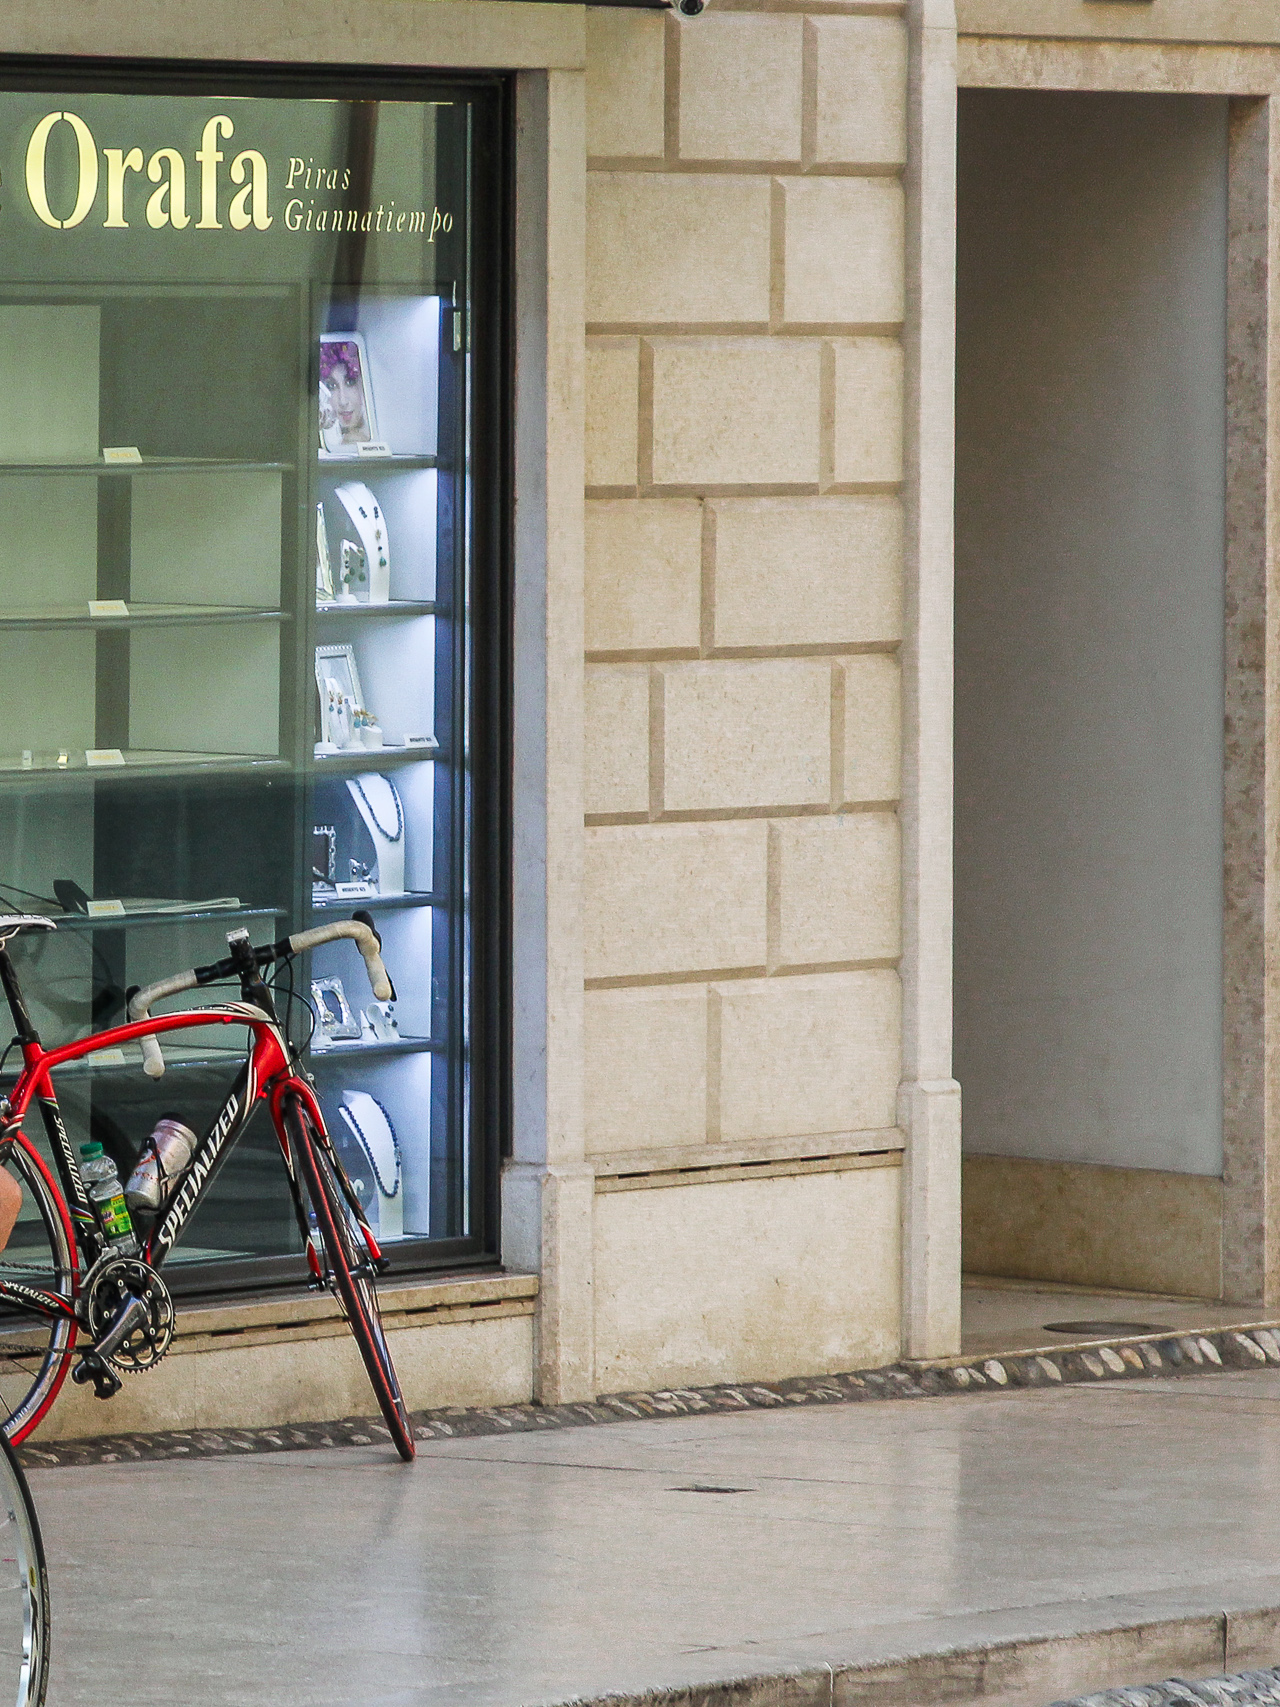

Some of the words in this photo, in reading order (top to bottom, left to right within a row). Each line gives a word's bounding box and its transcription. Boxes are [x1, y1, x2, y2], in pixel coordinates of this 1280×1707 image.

[24, 111, 273, 231] Orafa
[285, 157, 351, 190] Piras
[284, 198, 454, 243] Giannatiempo
[53, 1114, 89, 1204] SPECIALIZED
[158, 1093, 240, 1250] SPECIALIZED
[3, 1280, 60, 1308] SPECIALIZED
